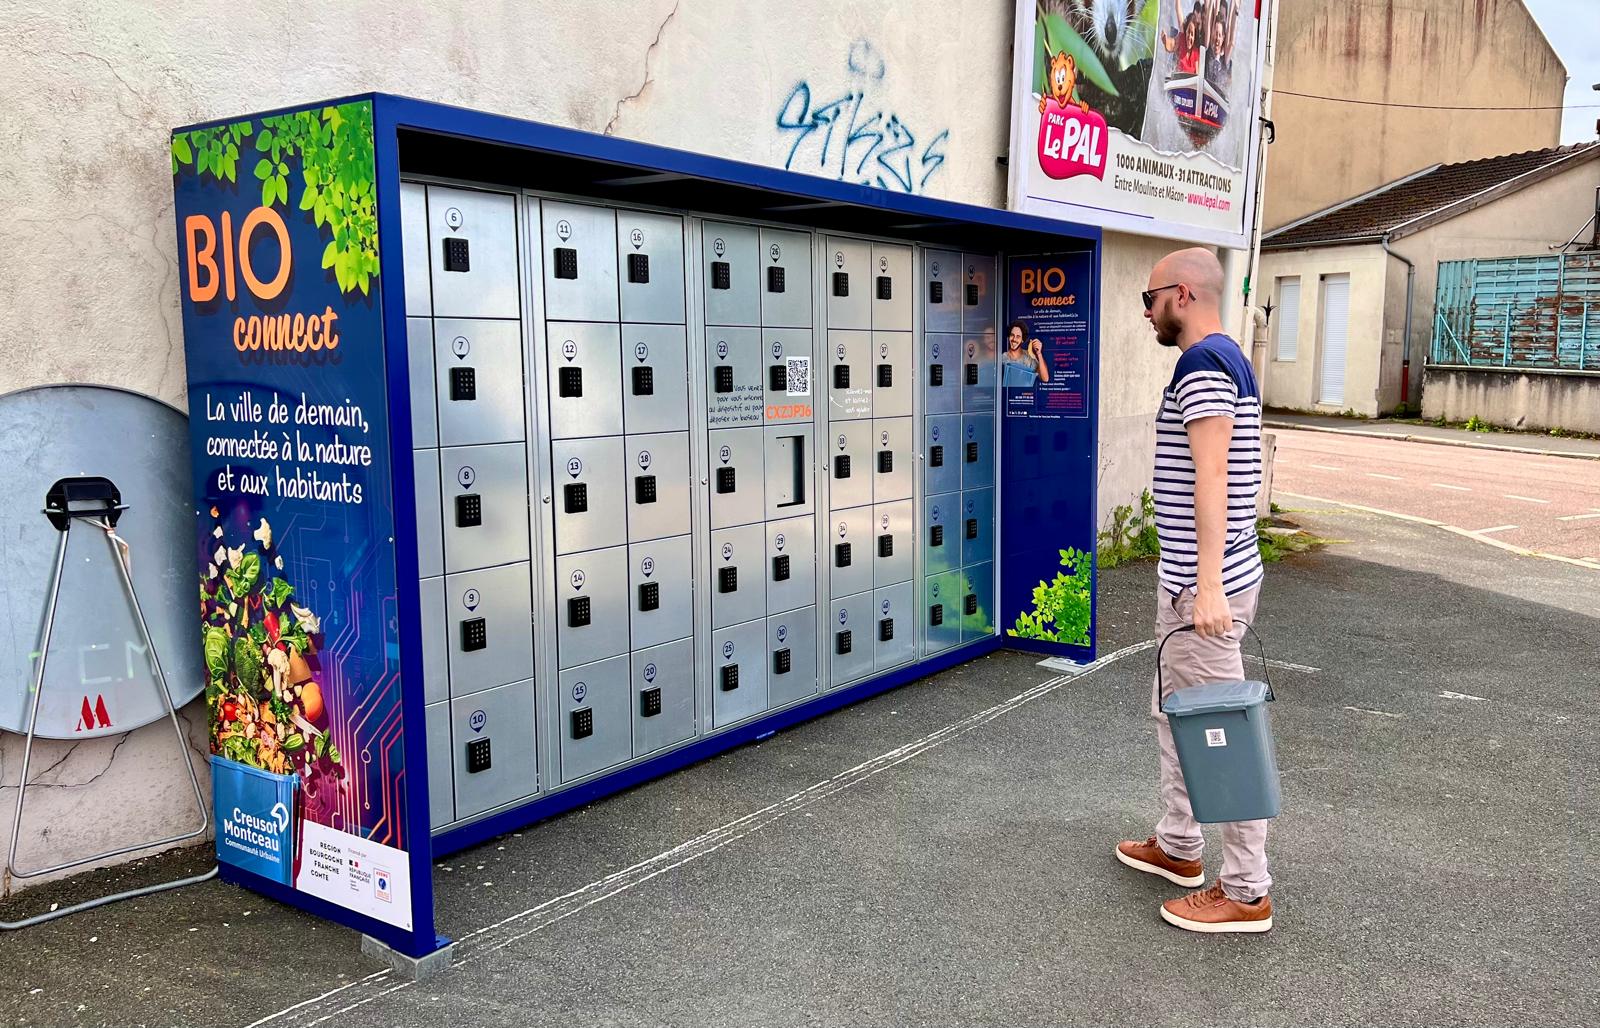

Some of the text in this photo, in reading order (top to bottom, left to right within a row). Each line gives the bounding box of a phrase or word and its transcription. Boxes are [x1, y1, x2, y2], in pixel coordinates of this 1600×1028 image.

[1049, 113, 1064, 127] PARC
[1044, 118, 1102, 167] Le PAL
[1116, 154, 1135, 170] 1000
[1136, 157, 1174, 179] ANIMAUX
[1179, 168, 1186, 182] 31
[1186, 169, 1232, 193] ATTRACTIONS
[1115, 175, 1132, 192] Entre
[1133, 179, 1158, 198] Moulins
[1159, 186, 1165, 199] et
[1166, 185, 1184, 202] Mâcon
[1188, 192, 1231, 212] www.lepal.com
[451, 213, 457, 222] 6
[560, 224, 569, 234] 11
[633, 234, 641, 242] 16
[716, 242, 723, 250] 21
[186, 206, 291, 301] BIO
[772, 248, 779, 256] 26
[1021, 268, 1066, 294] BIO
[1032, 294, 1076, 306] connect
[233, 306, 338, 352] connect
[458, 341, 464, 350] 7
[565, 345, 574, 354] 12
[718, 345, 726, 353] 22
[774, 345, 781, 353] 27
[638, 347, 646, 355] 17
[206, 391, 369, 433] La ville de demain,
[207, 429, 372, 466] connectée à la nature
[640, 455, 649, 463] 18
[570, 462, 579, 471] 13
[463, 471, 470, 480] 8
[218, 464, 362, 504] et aux habitants
[777, 537, 784, 545] 29
[724, 547, 731, 555] 24
[644, 562, 652, 570] 19
[573, 574, 583, 583] 14
[468, 593, 474, 602] 9
[646, 667, 654, 676] 20
[575, 686, 584, 695] 15
[472, 714, 483, 725] 10
[234, 807, 278, 836] Creusot
[224, 819, 279, 852] Montceau
[225, 838, 280, 864] Communauté Urbaine
[310, 849, 343, 866] BOURGOGNE
[314, 860, 340, 874] FRANCHE
[311, 870, 329, 881] COMTE
